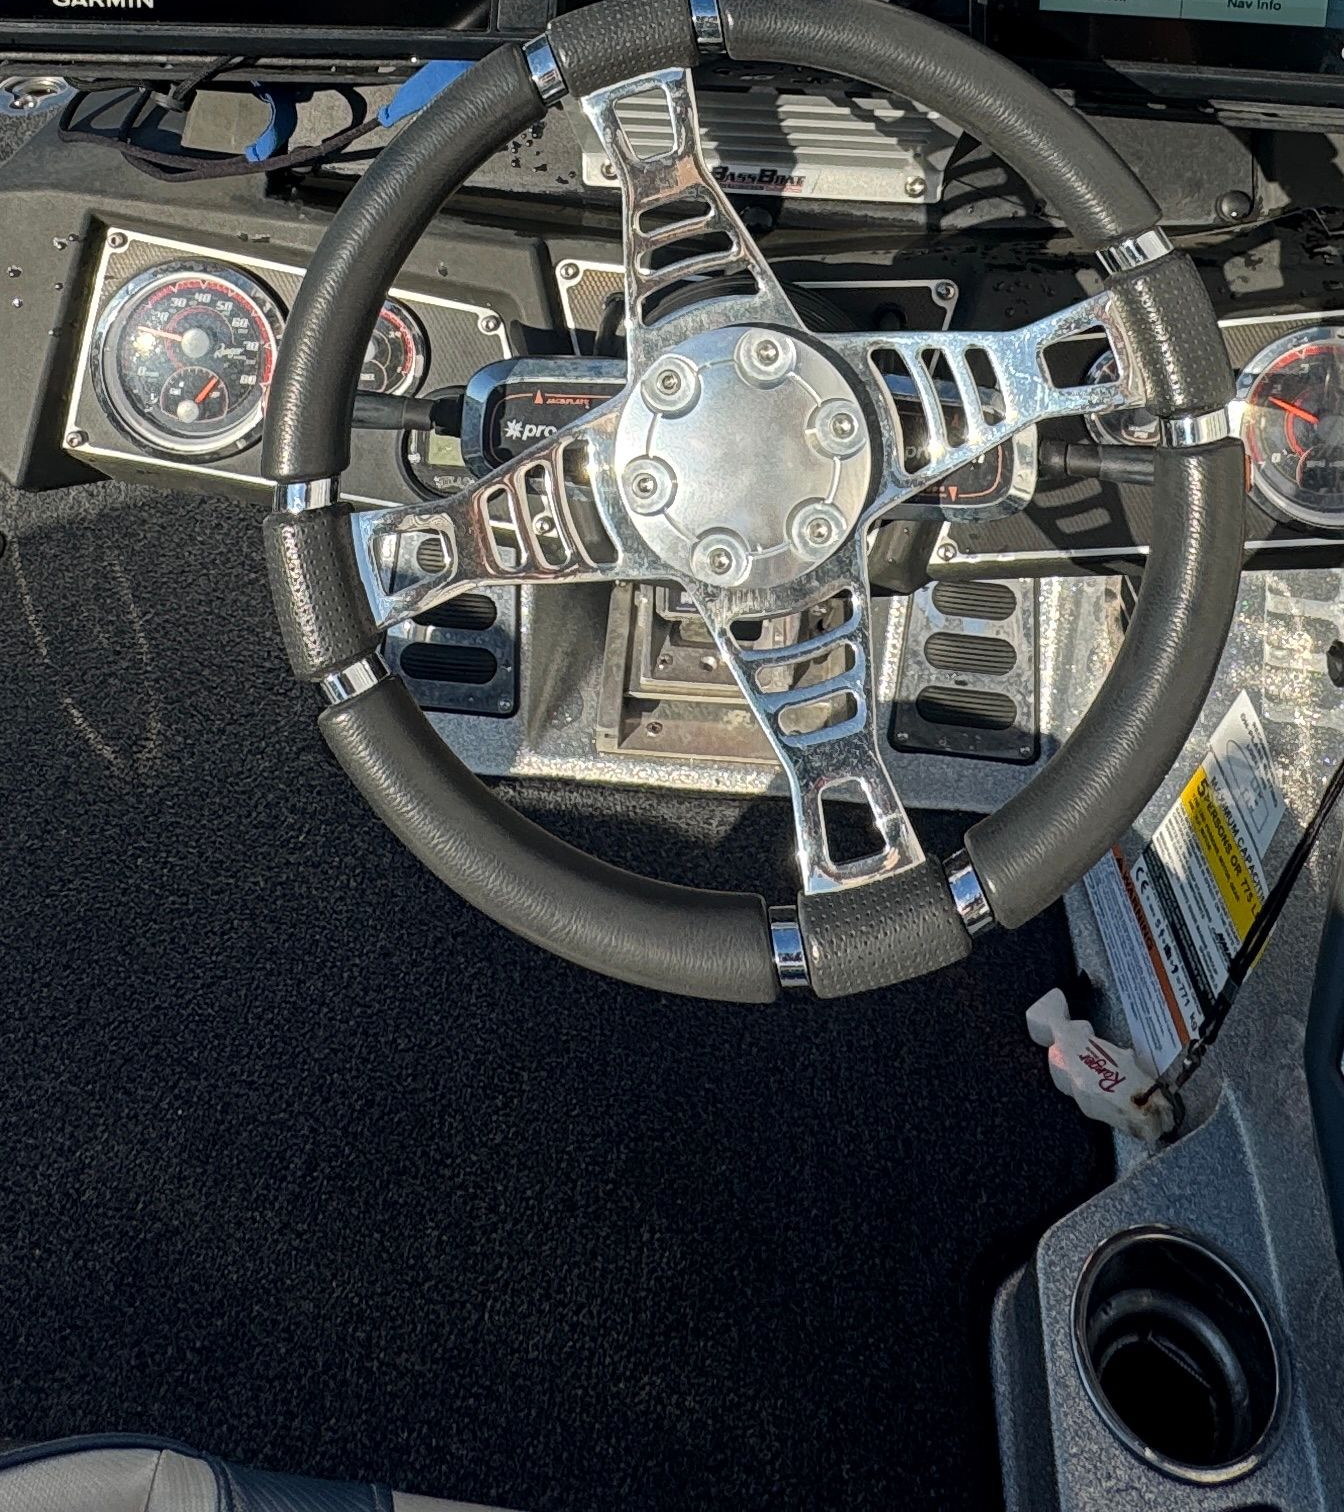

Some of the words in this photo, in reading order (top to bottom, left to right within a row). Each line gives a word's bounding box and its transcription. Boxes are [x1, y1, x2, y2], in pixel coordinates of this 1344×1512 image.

[1256, 0, 1282, 12] Info
[170, 297, 187, 308] 30
[194, 293, 212, 303] 40
[215, 301, 234, 312] 50
[1195, 776, 1210, 799] 5
[1202, 791, 1233, 856] PERSONS
[1228, 852, 1242, 878] OR
